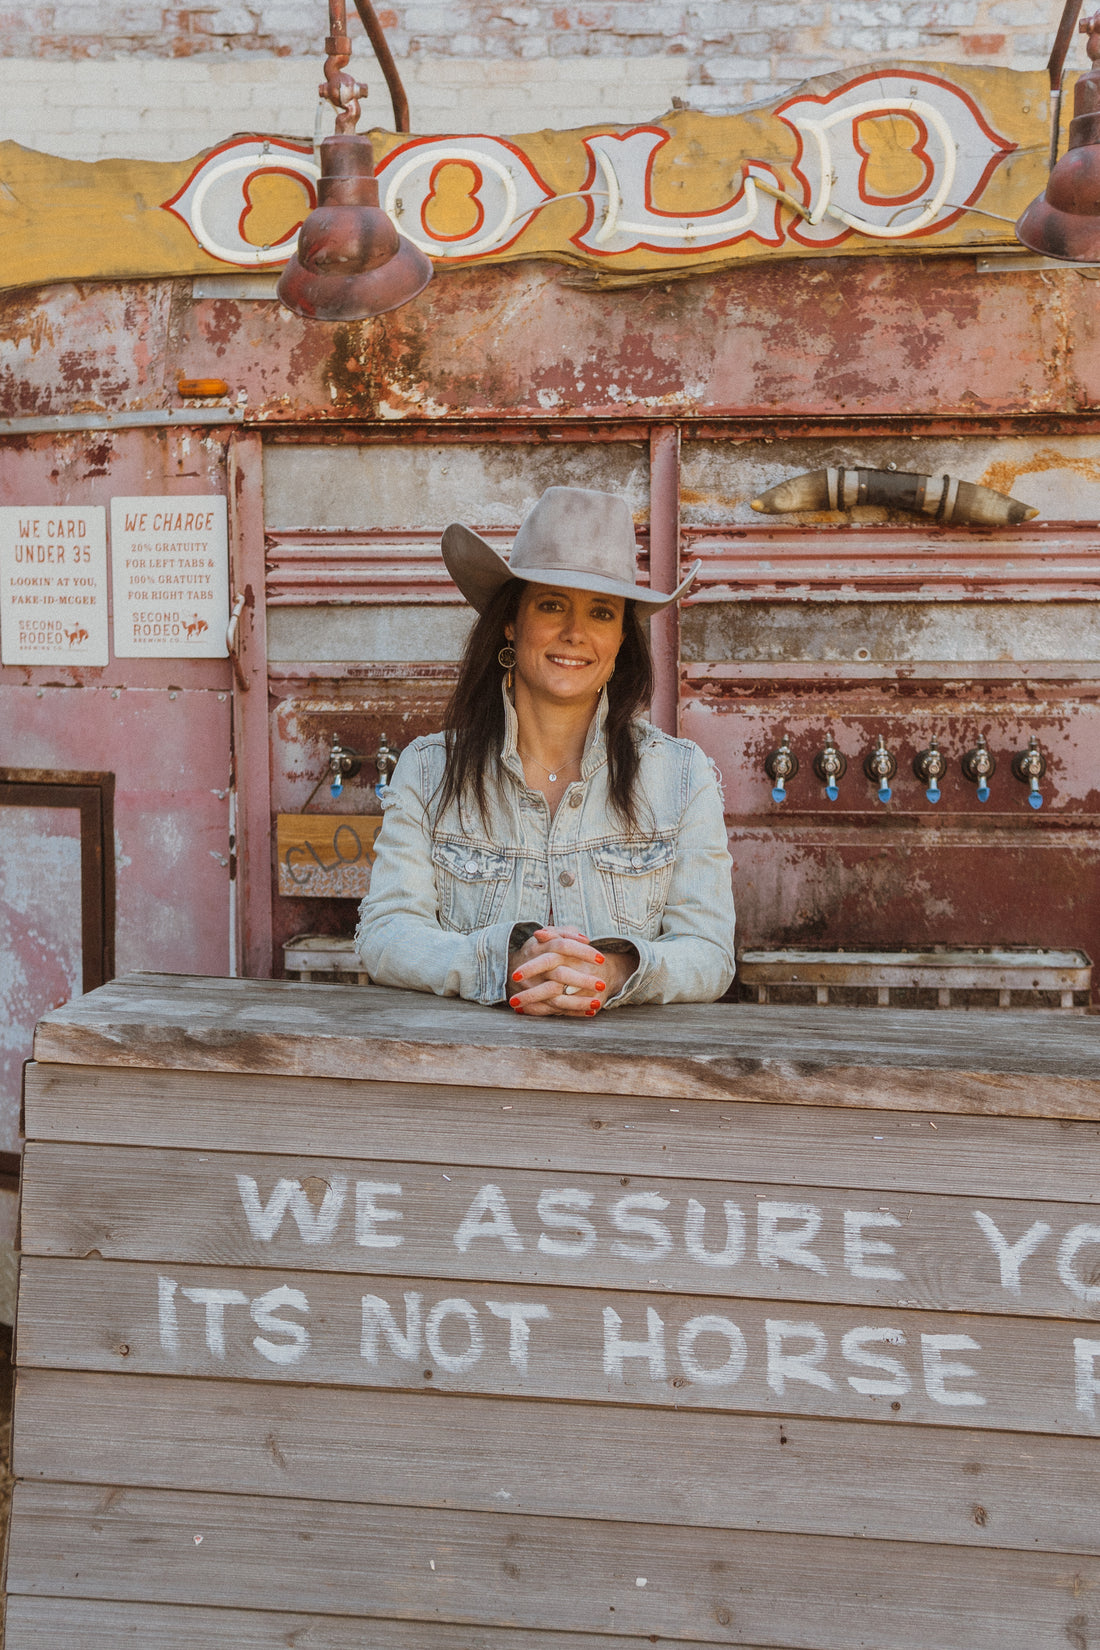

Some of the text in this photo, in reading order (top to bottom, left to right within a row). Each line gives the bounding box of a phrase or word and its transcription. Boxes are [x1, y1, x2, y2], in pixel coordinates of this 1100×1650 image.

[161, 69, 1018, 269] COLD
[19, 519, 87, 538] WE CARD
[124, 512, 215, 532] WE CHARGE
[15, 544, 91, 563] UNDER 35
[131, 542, 209, 552] 20% GRATUITY
[125, 558, 215, 568] FOR LEFT TABS &
[57, 577, 70, 586] AT
[129, 574, 212, 584] 100% GRATUITY
[127, 591, 214, 600] FOR RIGHT TABS
[132, 612, 180, 622] SECOND
[19, 620, 63, 631] SECOND
[133, 623, 180, 636] RODEO
[20, 631, 63, 644] RODEO
[236, 1174, 403, 1248] WE
[453, 1183, 905, 1281] ASSURE
[157, 1273, 312, 1366] ITS
[360, 1291, 551, 1377] NOT
[602, 1305, 987, 1407] HORSE
